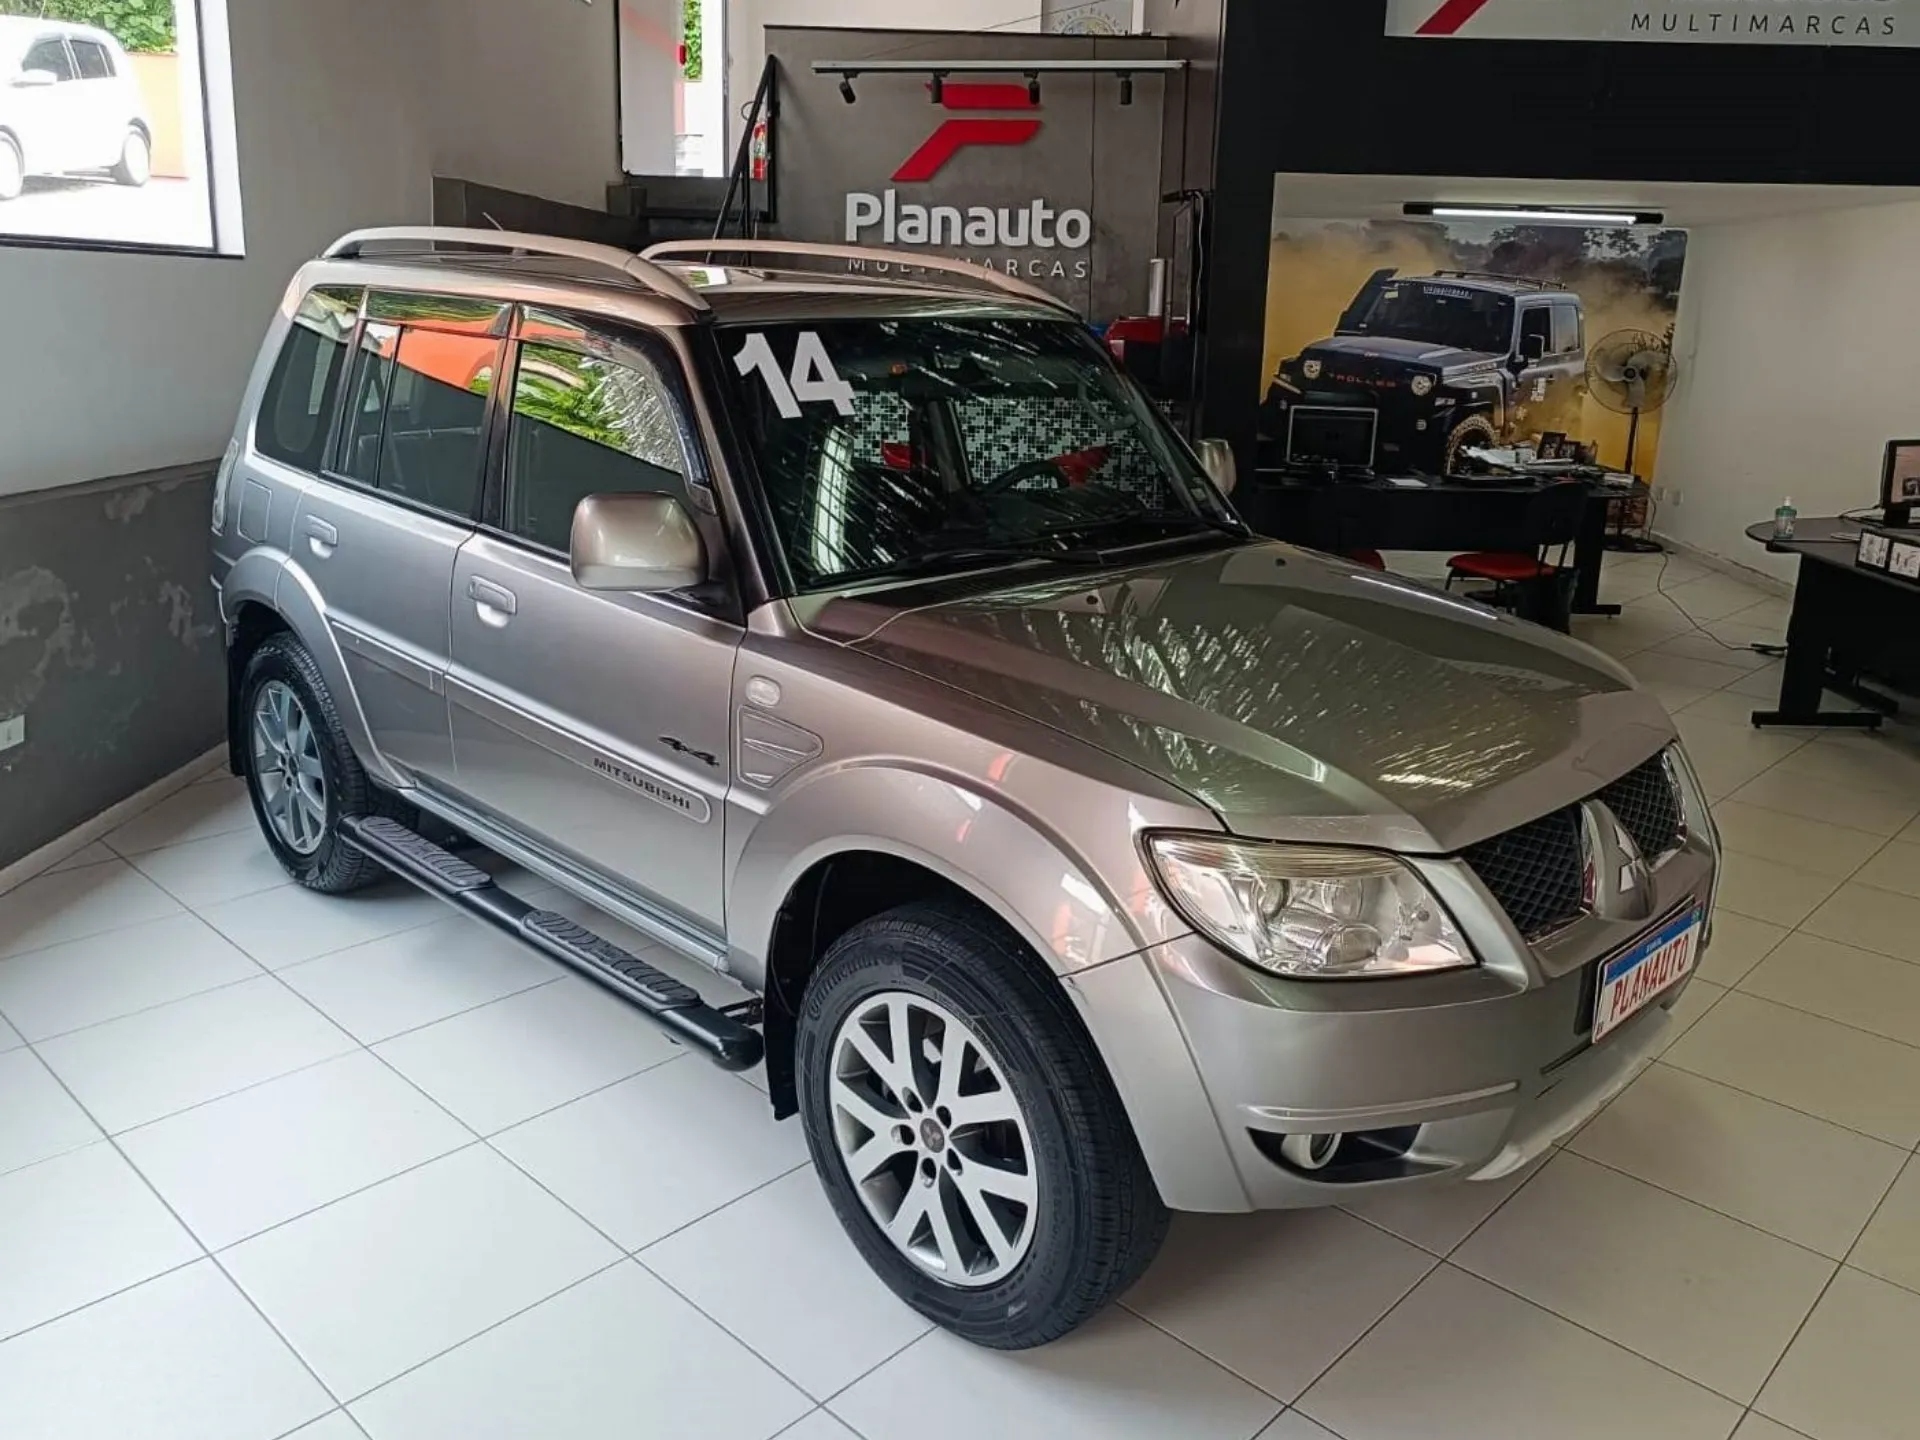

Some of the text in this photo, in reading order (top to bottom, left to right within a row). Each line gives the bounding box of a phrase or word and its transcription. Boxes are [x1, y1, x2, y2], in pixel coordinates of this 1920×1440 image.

[1630, 13, 1896, 36] MULTIMARCAS
[845, 188, 1091, 248] Planauto
[732, 331, 857, 419] 14
[593, 757, 690, 810] MITSUBISHI
[1609, 933, 1689, 1022] PLANAUTO
